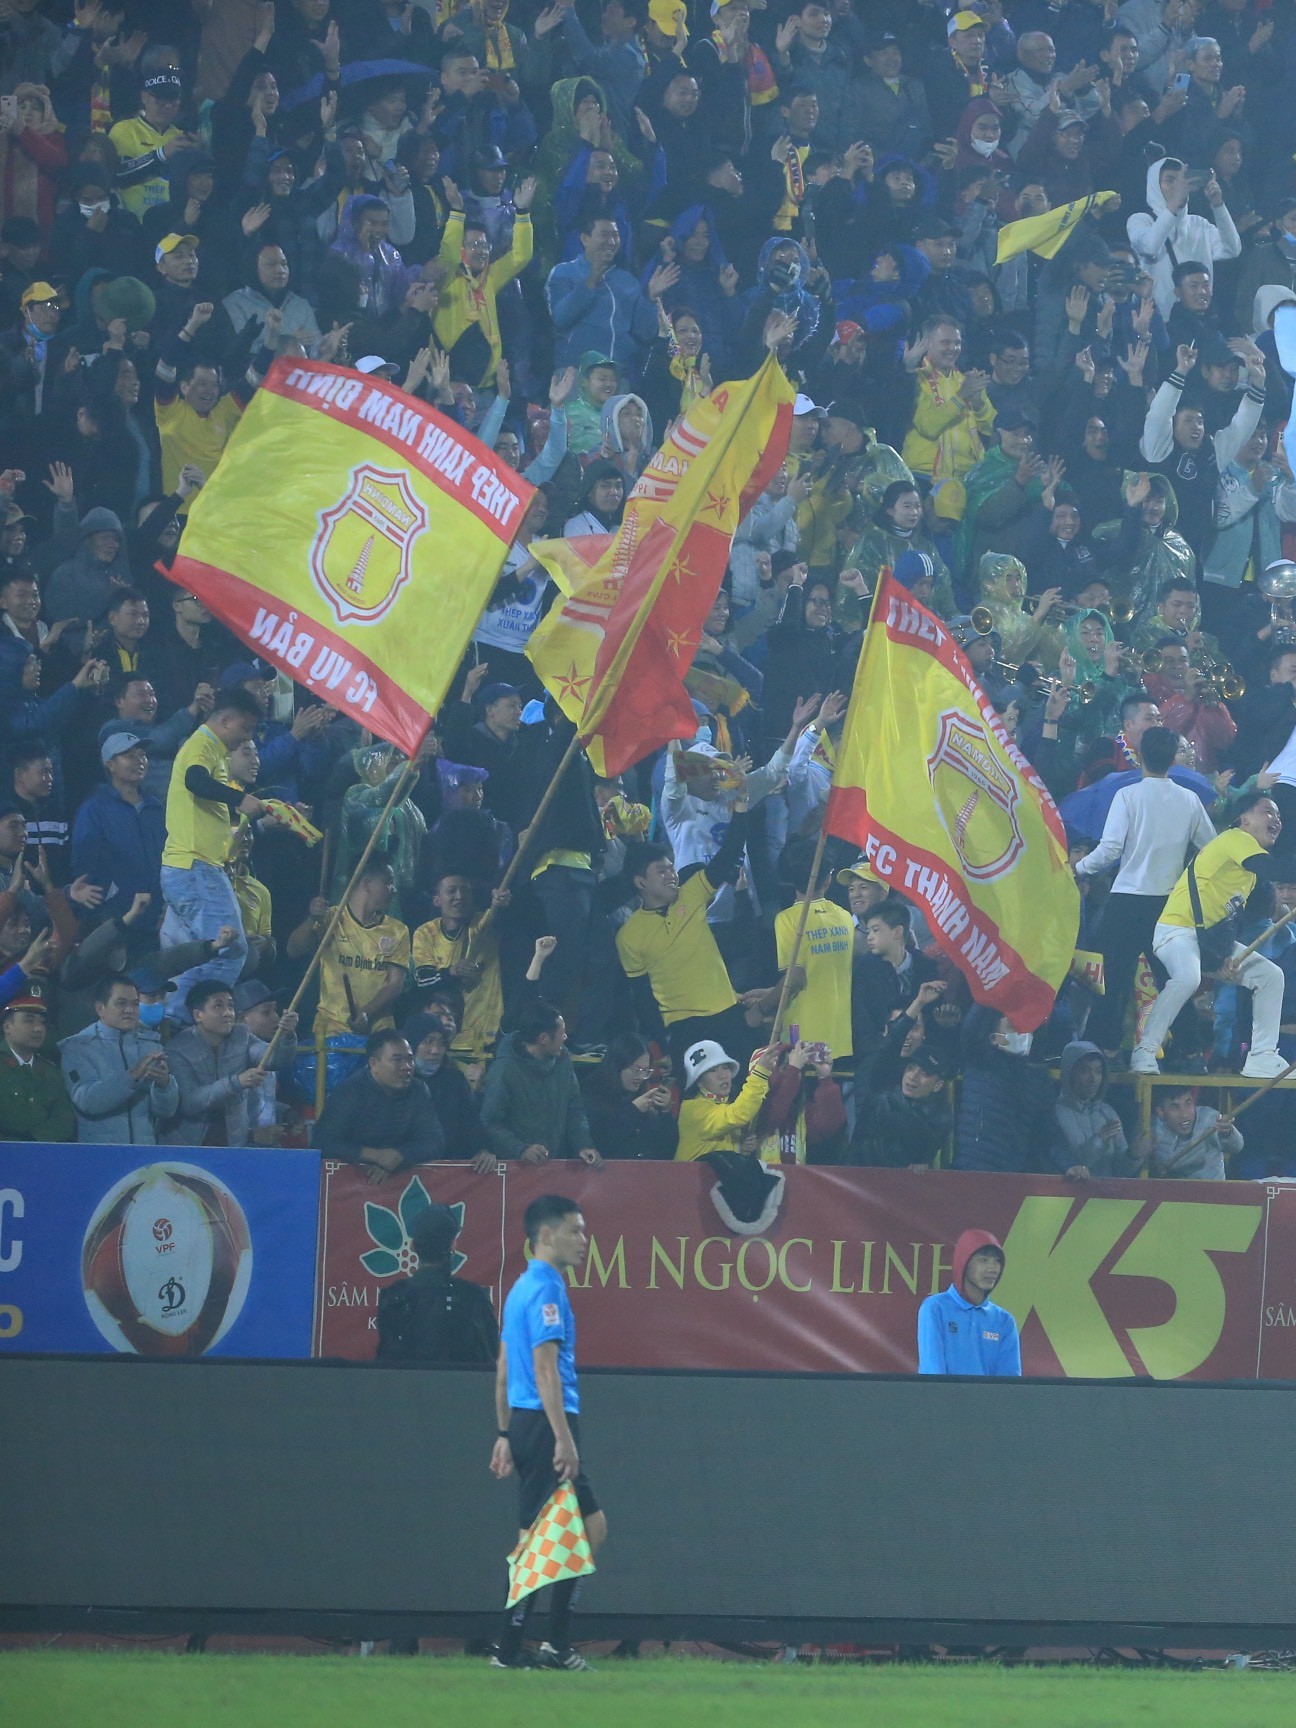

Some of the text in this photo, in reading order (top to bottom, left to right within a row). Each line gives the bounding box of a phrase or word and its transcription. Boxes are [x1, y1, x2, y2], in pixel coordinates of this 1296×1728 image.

[886, 595, 947, 648] TH
[865, 833, 897, 875] FC
[904, 858, 971, 942] THÀNH
[960, 925, 1011, 991] NAM
[155, 1242, 176, 1255] VPF
[646, 1236, 814, 1303] NGỌC
[327, 1281, 369, 1307] SÂM
[1002, 1196, 1263, 1380] K5
